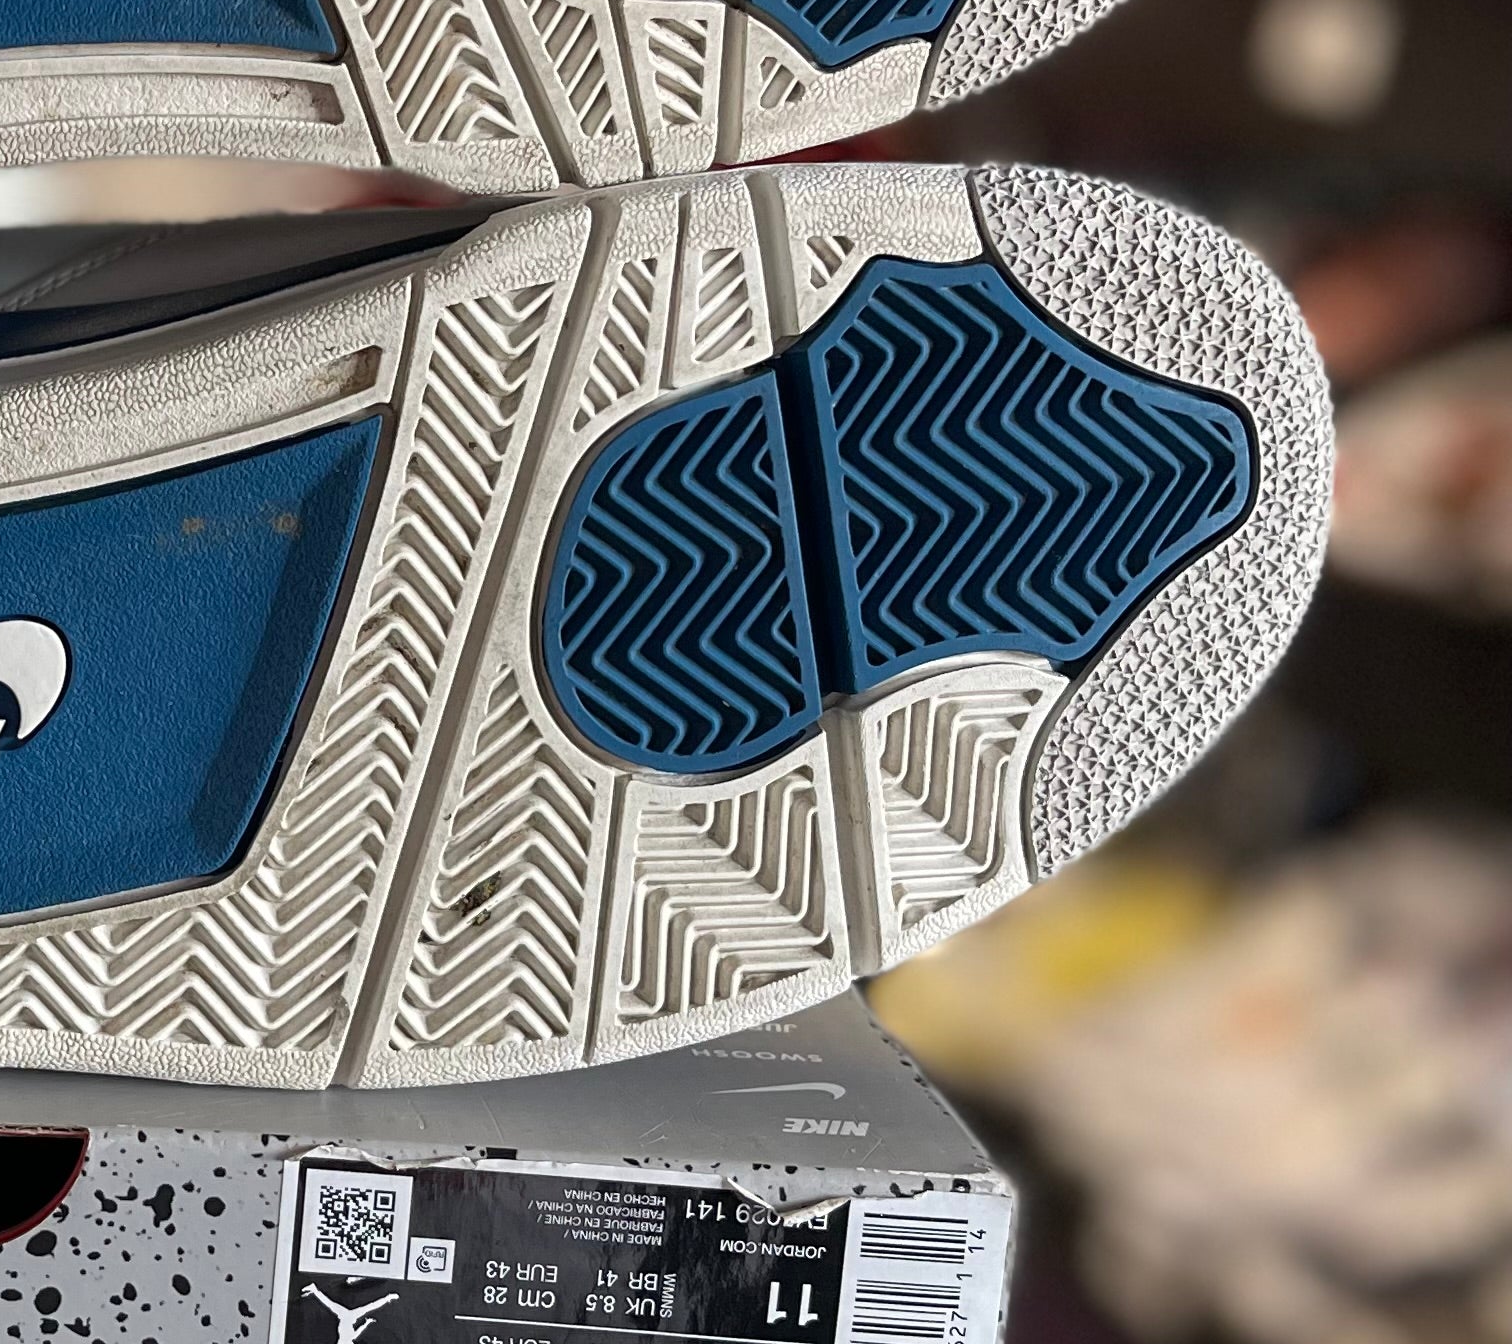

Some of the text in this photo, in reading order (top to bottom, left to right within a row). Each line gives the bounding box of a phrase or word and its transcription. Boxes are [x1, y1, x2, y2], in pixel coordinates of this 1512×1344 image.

[691, 1048, 823, 1063] SWOOSH
[782, 1117, 870, 1137] NIKE
[564, 1188, 666, 1206] HECHO EN CHINA
[536, 1200, 573, 1213] CHINA
[576, 1203, 593, 1214] NA
[596, 1205, 665, 1220] FABRICADO
[685, 1199, 726, 1222] 141
[544, 1213, 582, 1227] CHINE
[584, 1216, 600, 1228] EN
[604, 1218, 664, 1232] FABRIQUE
[571, 1229, 609, 1242] CHINA
[612, 1233, 624, 1244] IN
[626, 1234, 662, 1246] MADE
[968, 1228, 987, 1254] 14
[719, 1239, 827, 1259] JORDAN.COM
[486, 1260, 559, 1283] EUR 43
[597, 1269, 658, 1291] BR 41
[483, 1286, 556, 1309] cm 28
[586, 1293, 656, 1316] UK 8.5
[659, 1273, 677, 1319] WMNS
[767, 1281, 819, 1326] 11
